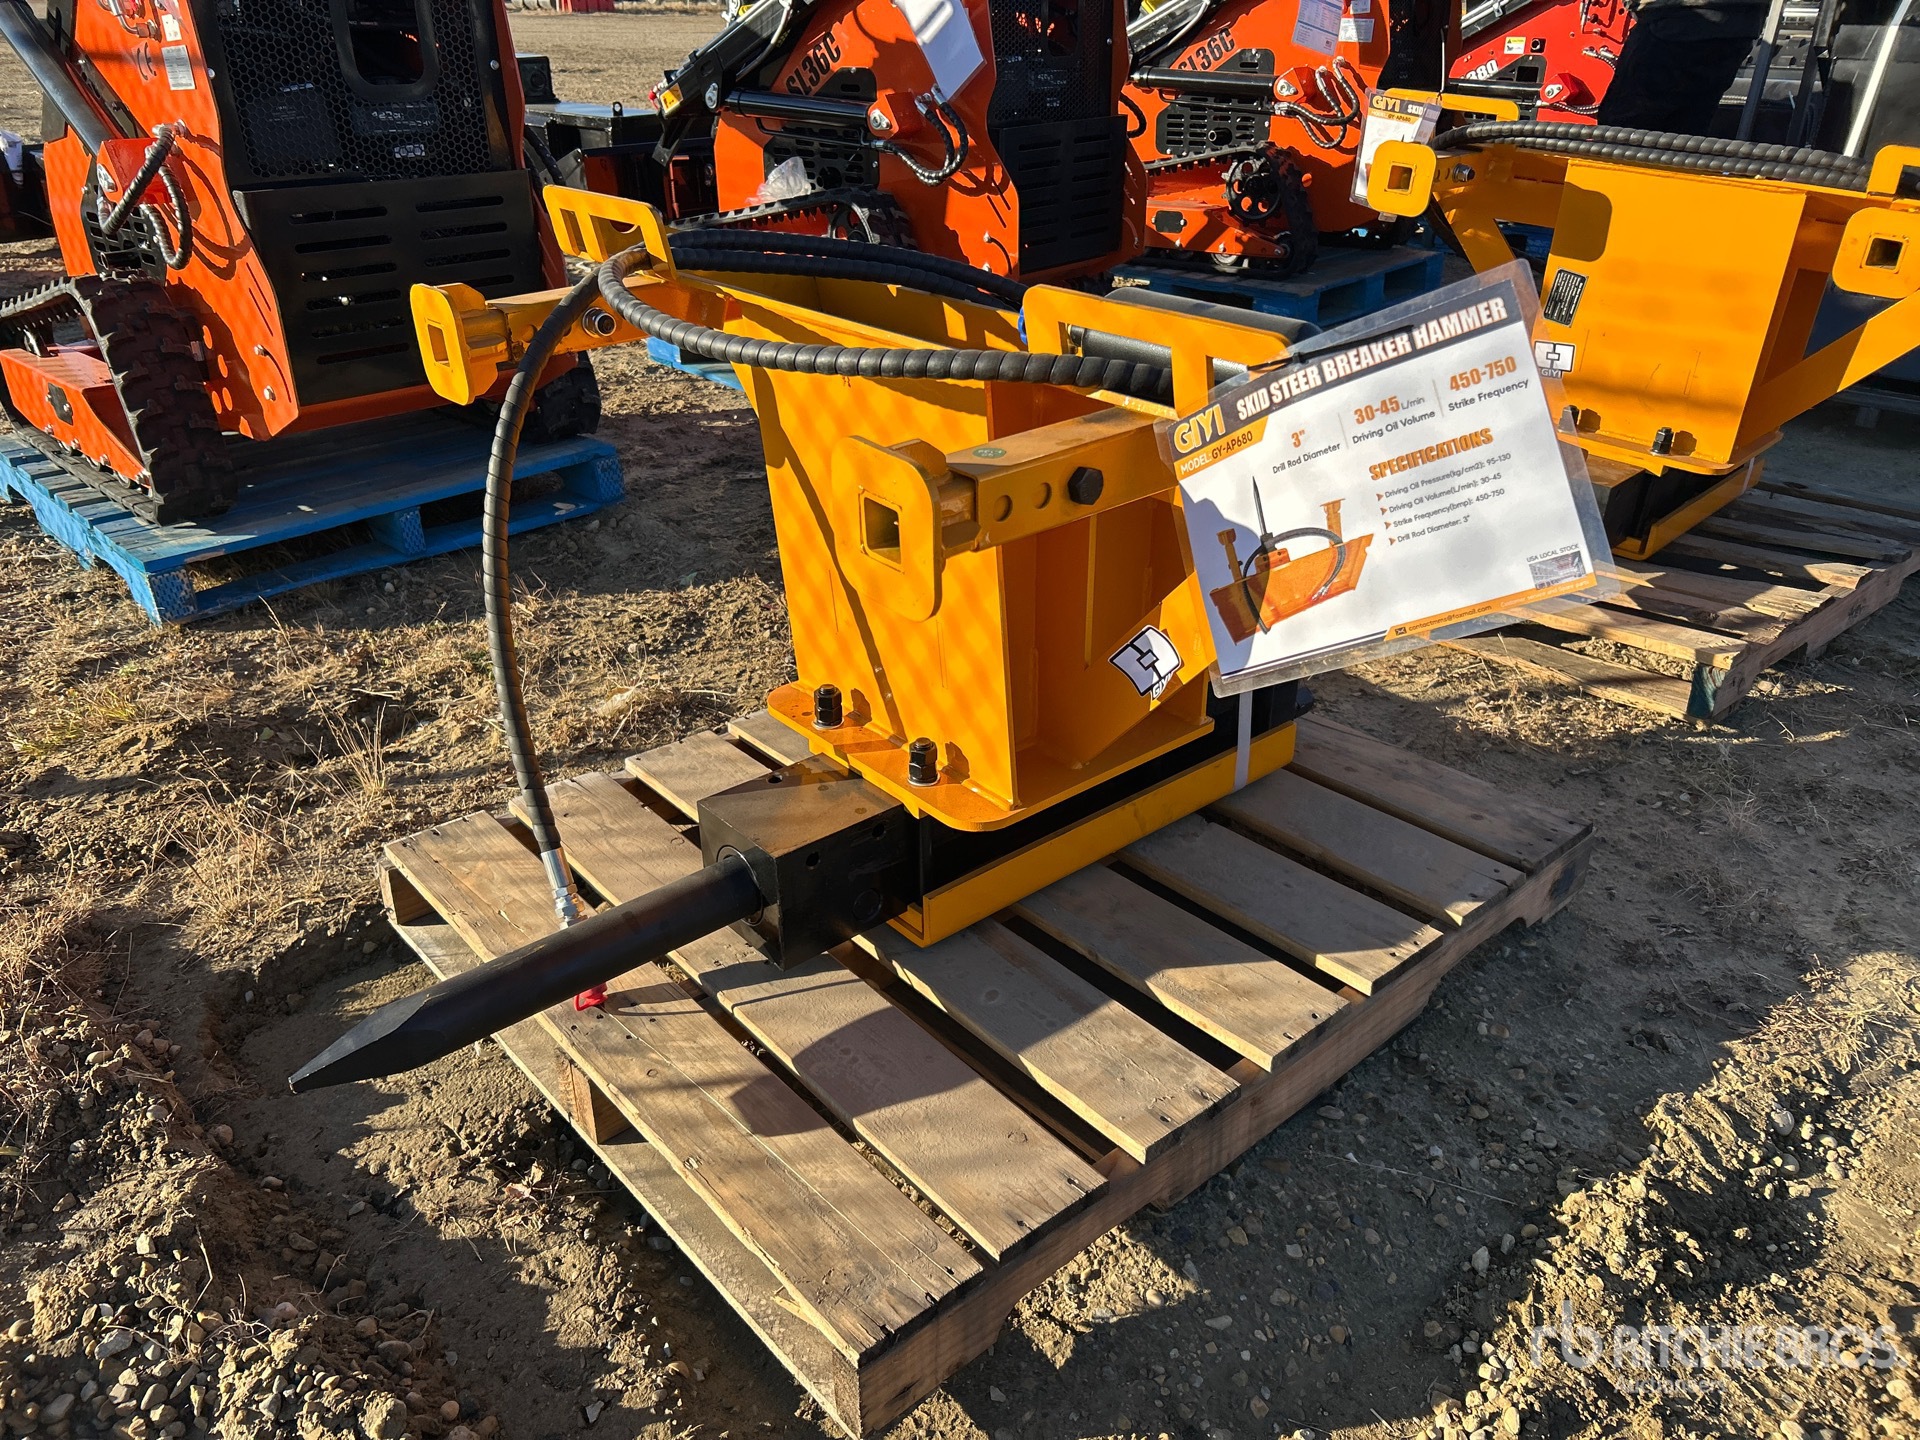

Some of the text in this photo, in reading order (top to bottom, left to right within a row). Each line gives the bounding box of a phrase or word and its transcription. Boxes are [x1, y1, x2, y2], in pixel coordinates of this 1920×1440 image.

[786, 32, 841, 96] SL36C
[1461, 59, 1499, 80] 380
[1372, 95, 1401, 112] GIYI
[1236, 387, 1271, 421] SKID
[1270, 363, 1323, 404] STEER
[1321, 333, 1413, 384] BREAKER
[1412, 297, 1509, 351] HAMMER
[1449, 355, 1518, 392] 450-750
[1353, 395, 1401, 425] 30-45
[1448, 378, 1530, 412] Strike Frequency
[1173, 403, 1226, 454] GIYI
[1352, 410, 1436, 445] Driving Oil Volume
[1272, 442, 1341, 474] Drill Rod Diameter
[1368, 427, 1494, 481] SPECIFICATIONS
[1384, 485, 1409, 499] Driving
[1409, 481, 1420, 491] Oil
[1486, 452, 1512, 466] 95-130
[1388, 500, 1413, 514] Driving
[1413, 496, 1424, 506] Oil
[1480, 472, 1502, 486] 30-45
[1392, 516, 1413, 528] Strike
[1475, 488, 1505, 502] 450-750
[1397, 533, 1411, 543] Drill
[1411, 528, 1427, 538] Rod
[1427, 518, 1463, 534] Diameter:
[1526, 543, 1580, 563] USA LOCAL STOCK
